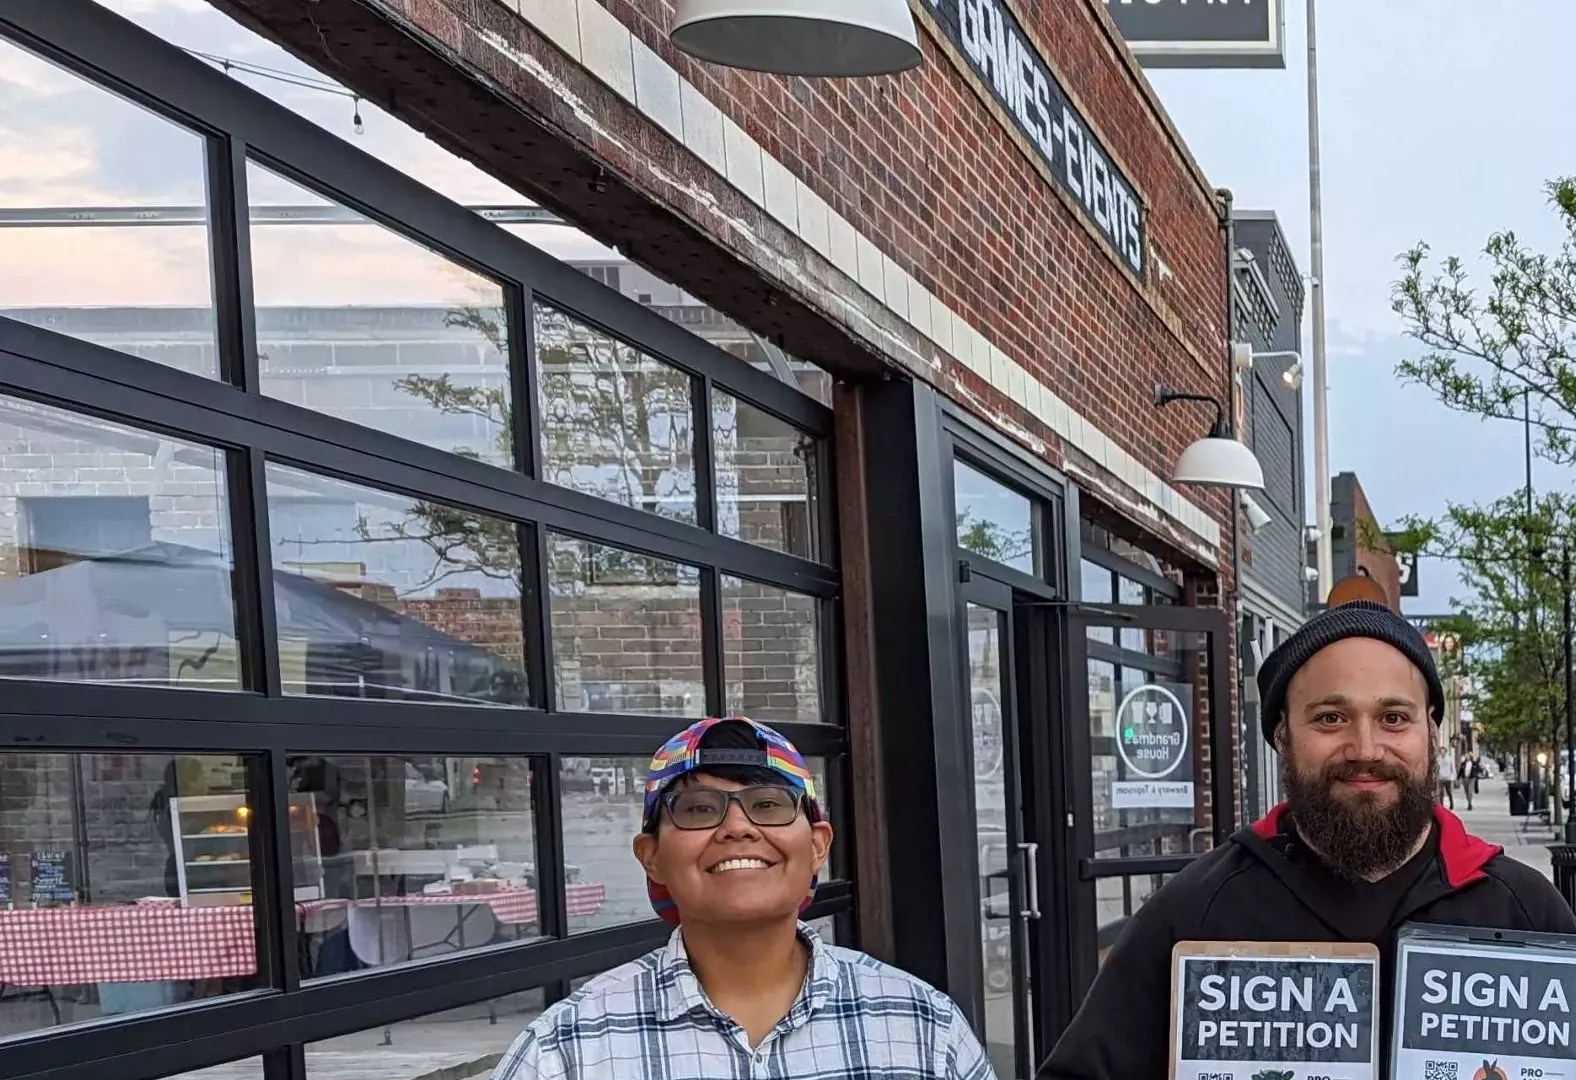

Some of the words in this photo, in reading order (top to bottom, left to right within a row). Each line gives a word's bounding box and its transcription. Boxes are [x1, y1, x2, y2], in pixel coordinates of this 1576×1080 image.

[1198, 974, 1312, 1012] SIGN
[1324, 978, 1358, 1012] A
[1421, 969, 1528, 1010] SIGN
[1538, 979, 1570, 1013] A
[1197, 1021, 1358, 1048] PETITION
[1421, 1012, 1570, 1047] PETITION
[1520, 1067, 1543, 1078] PRO
